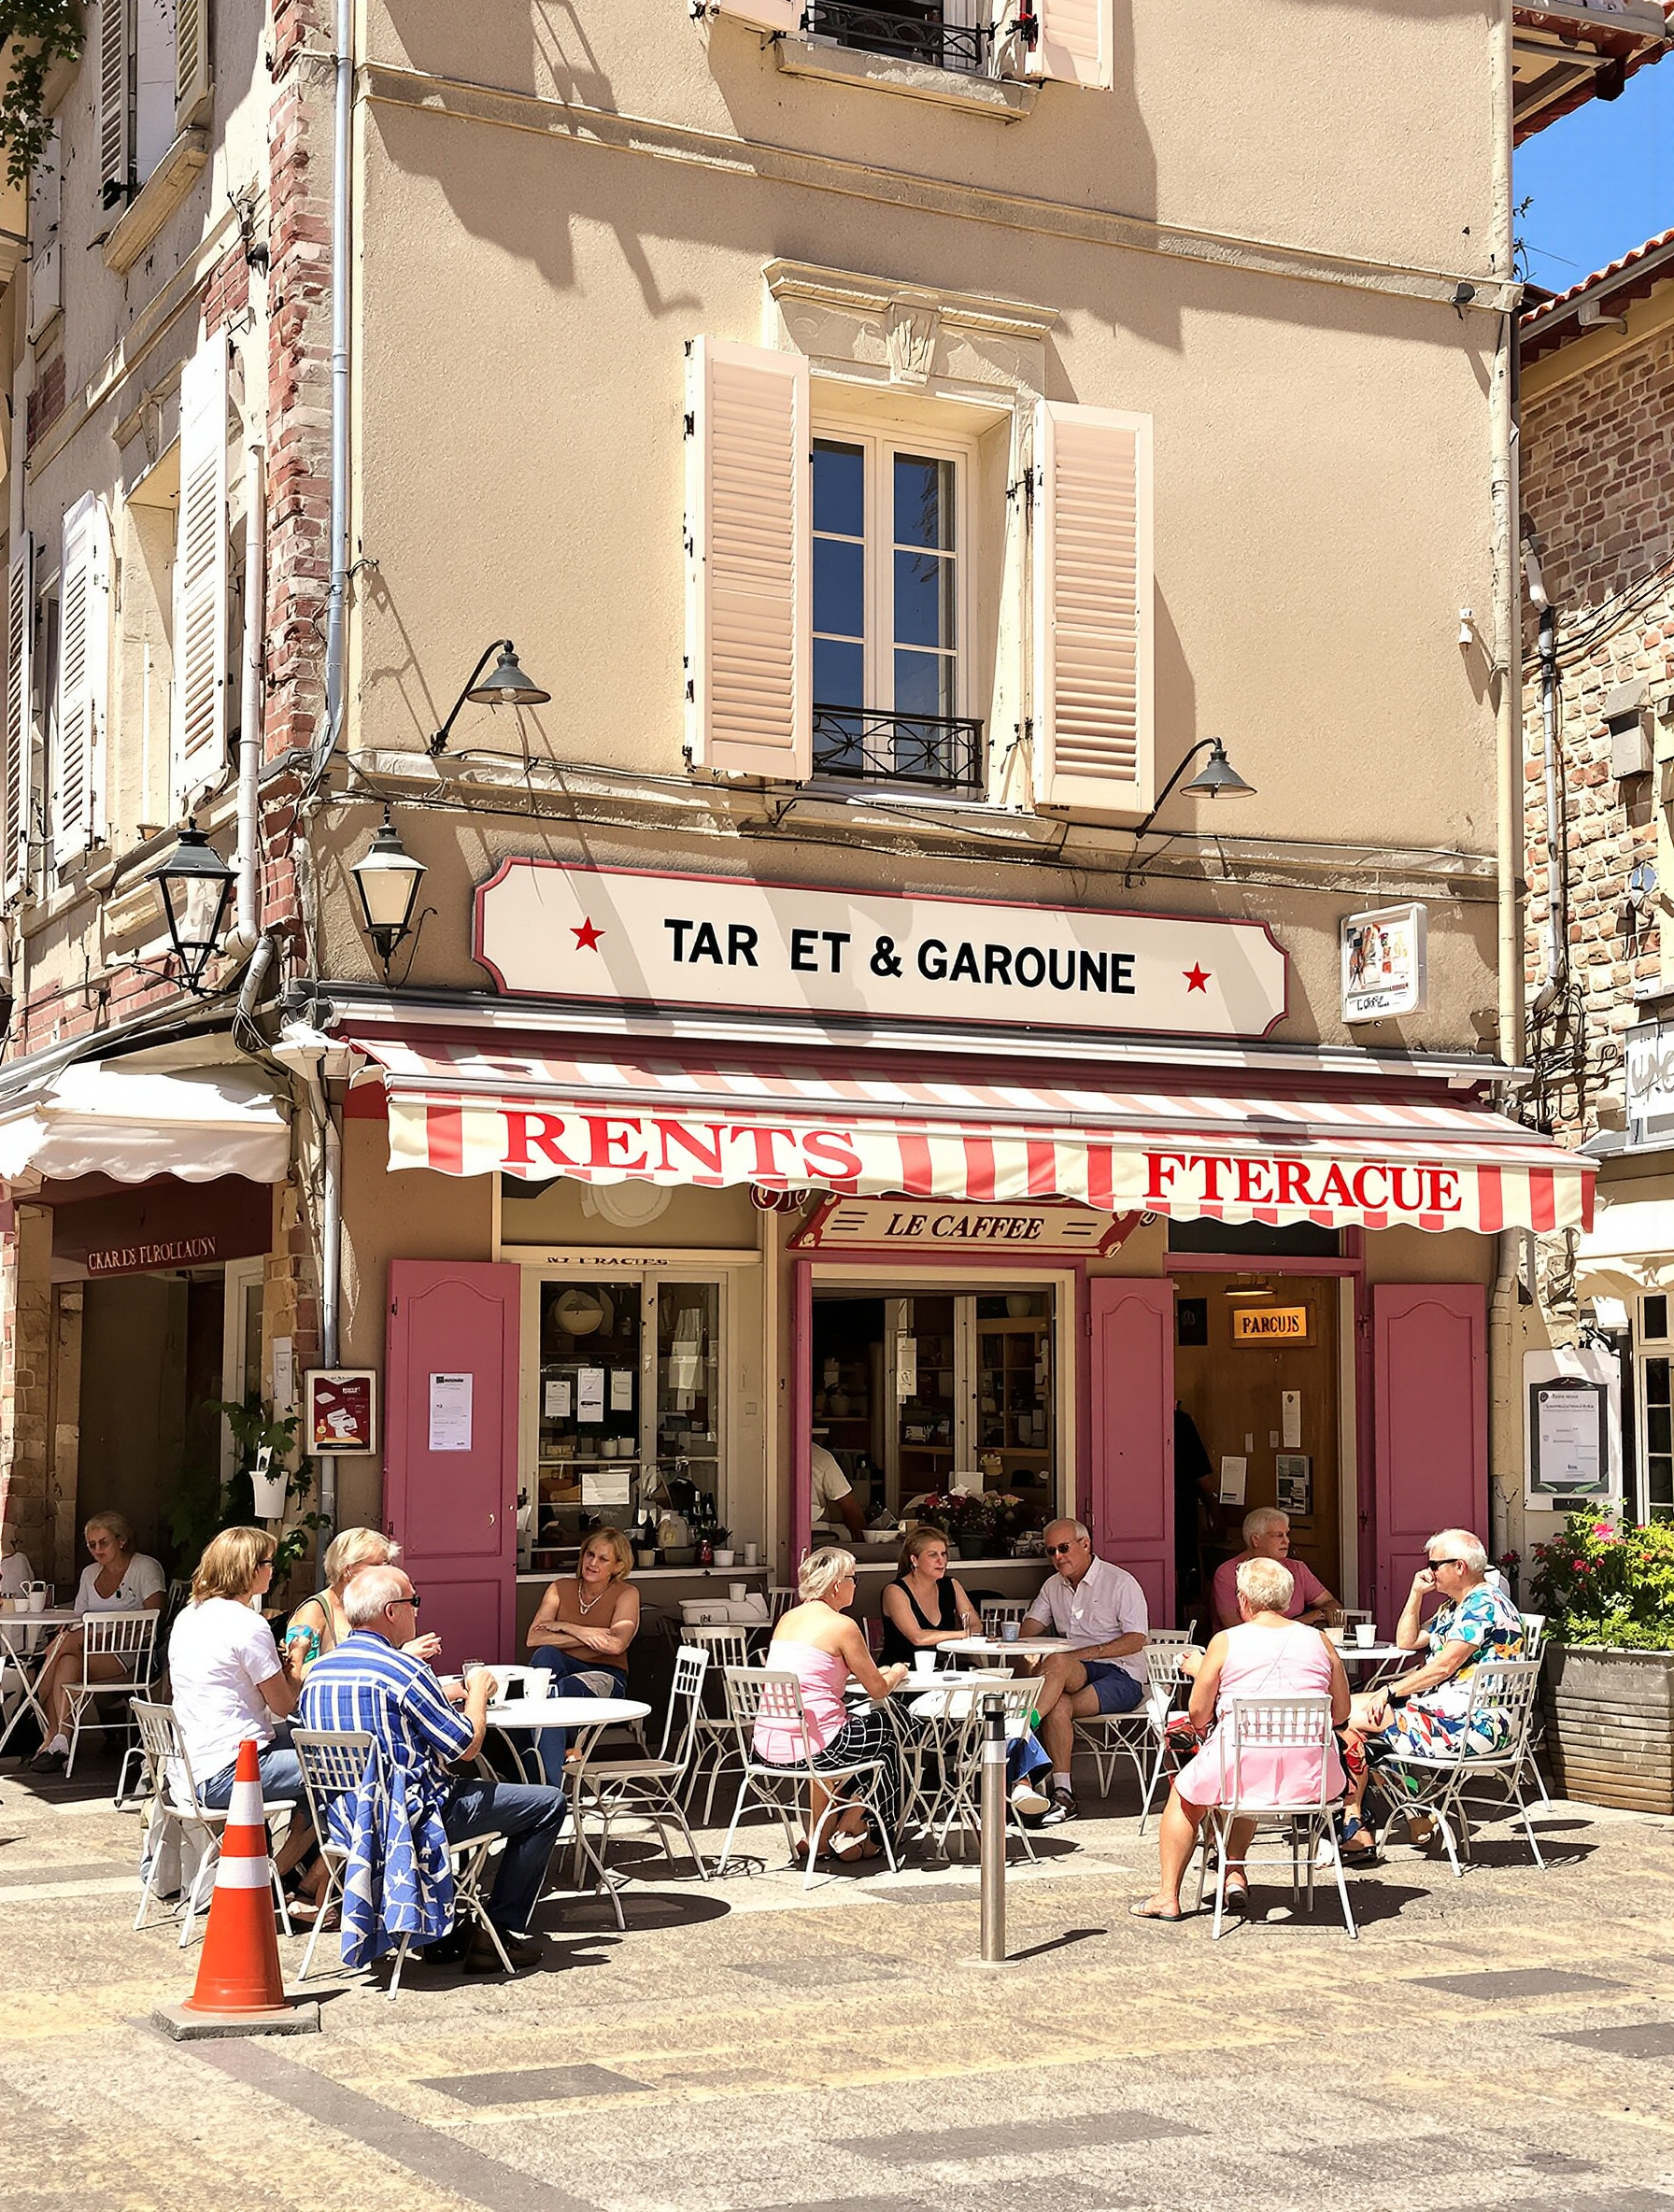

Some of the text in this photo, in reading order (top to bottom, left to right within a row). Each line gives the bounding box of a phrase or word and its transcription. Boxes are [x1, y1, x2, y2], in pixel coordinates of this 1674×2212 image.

[664, 917, 1136, 995] TAR ET & GAROUNE
[498, 1109, 863, 1181] RENTS
[1142, 1152, 1463, 1212] FTERACUE
[884, 1212, 1045, 1240] LE CAFFEE
